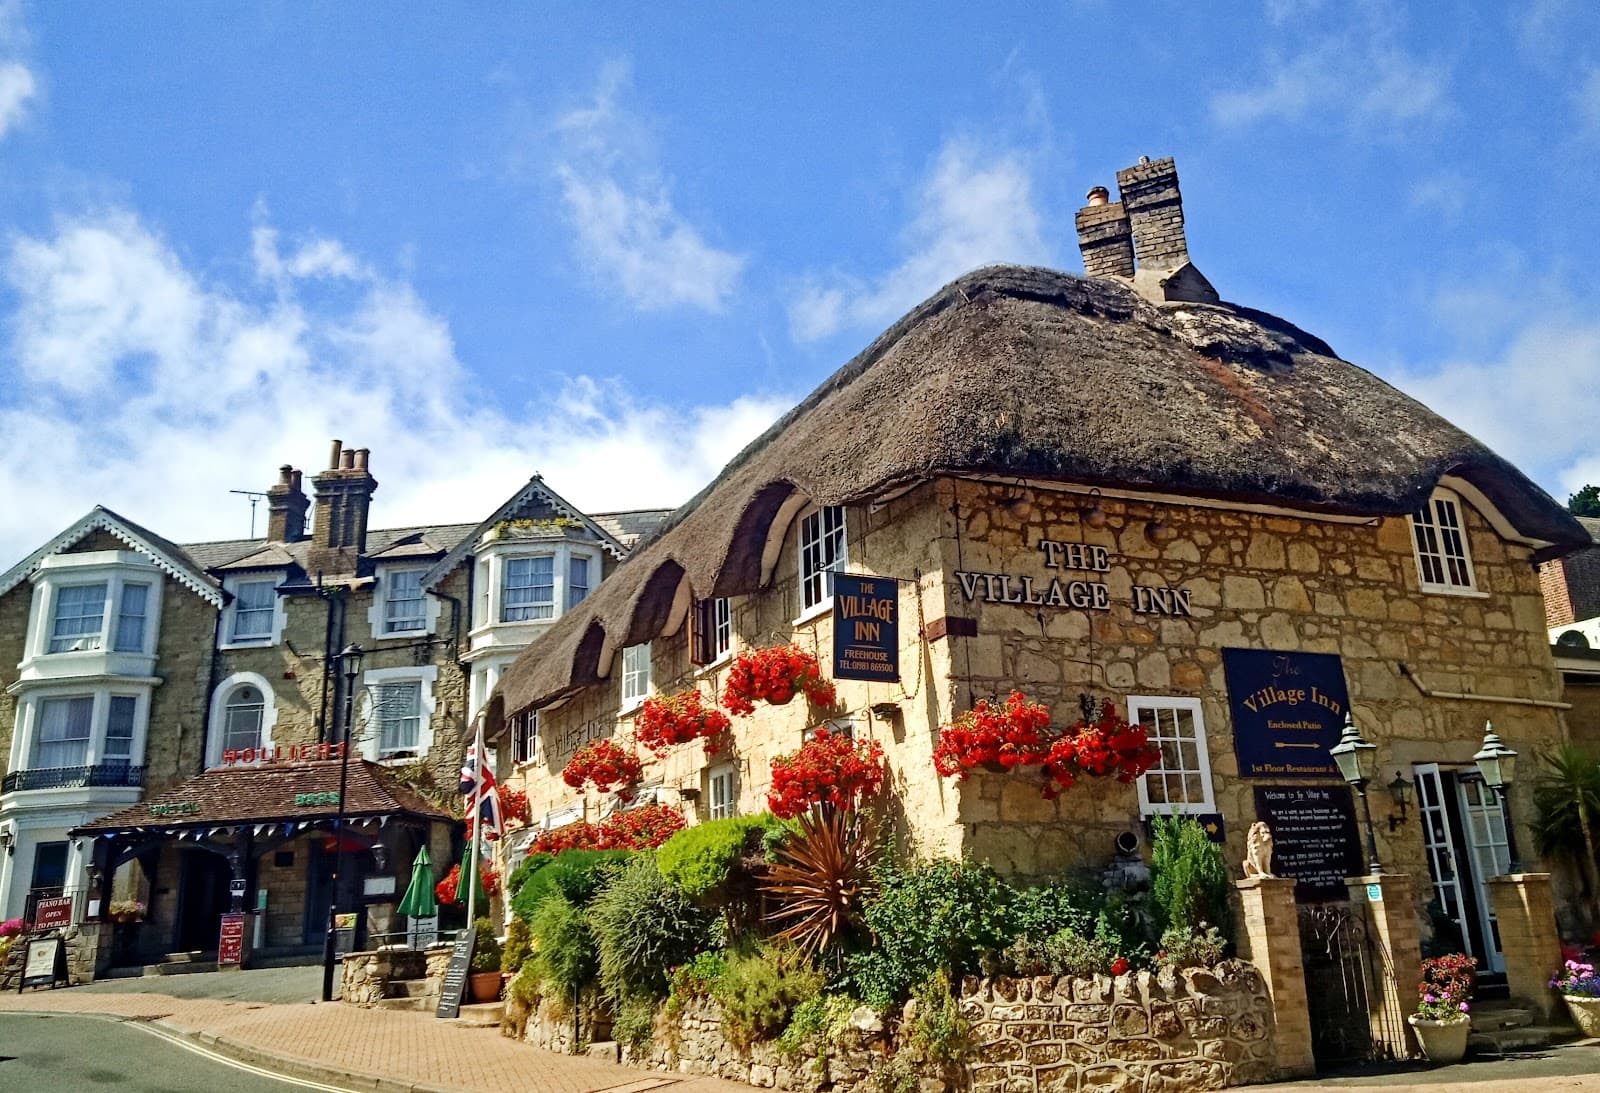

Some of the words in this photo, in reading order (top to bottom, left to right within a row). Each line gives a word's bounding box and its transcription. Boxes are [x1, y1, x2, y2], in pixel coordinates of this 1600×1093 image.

[1041, 540, 1111, 572] THE
[860, 583, 875, 594] THE
[956, 571, 1111, 610] VILLAGE
[1133, 586, 1193, 616] INN
[839, 595, 894, 625] VILLAGE
[854, 621, 881, 642] INN
[844, 649, 889, 662] FREEHOUSE
[1271, 655, 1301, 677] The
[1243, 686, 1306, 713] Village
[1311, 686, 1341, 716] Inn
[1267, 720, 1301, 730] Enclosed
[1302, 720, 1322, 730] Patio
[1251, 763, 1263, 773] 1st
[1264, 763, 1285, 773] Floor
[1286, 763, 1327, 773] Restaurant
[38, 900, 58, 910] PIANO
[58, 898, 71, 906] BAR
[45, 910, 62, 918] OPEN
[46, 919, 69, 928] PUBLIC
